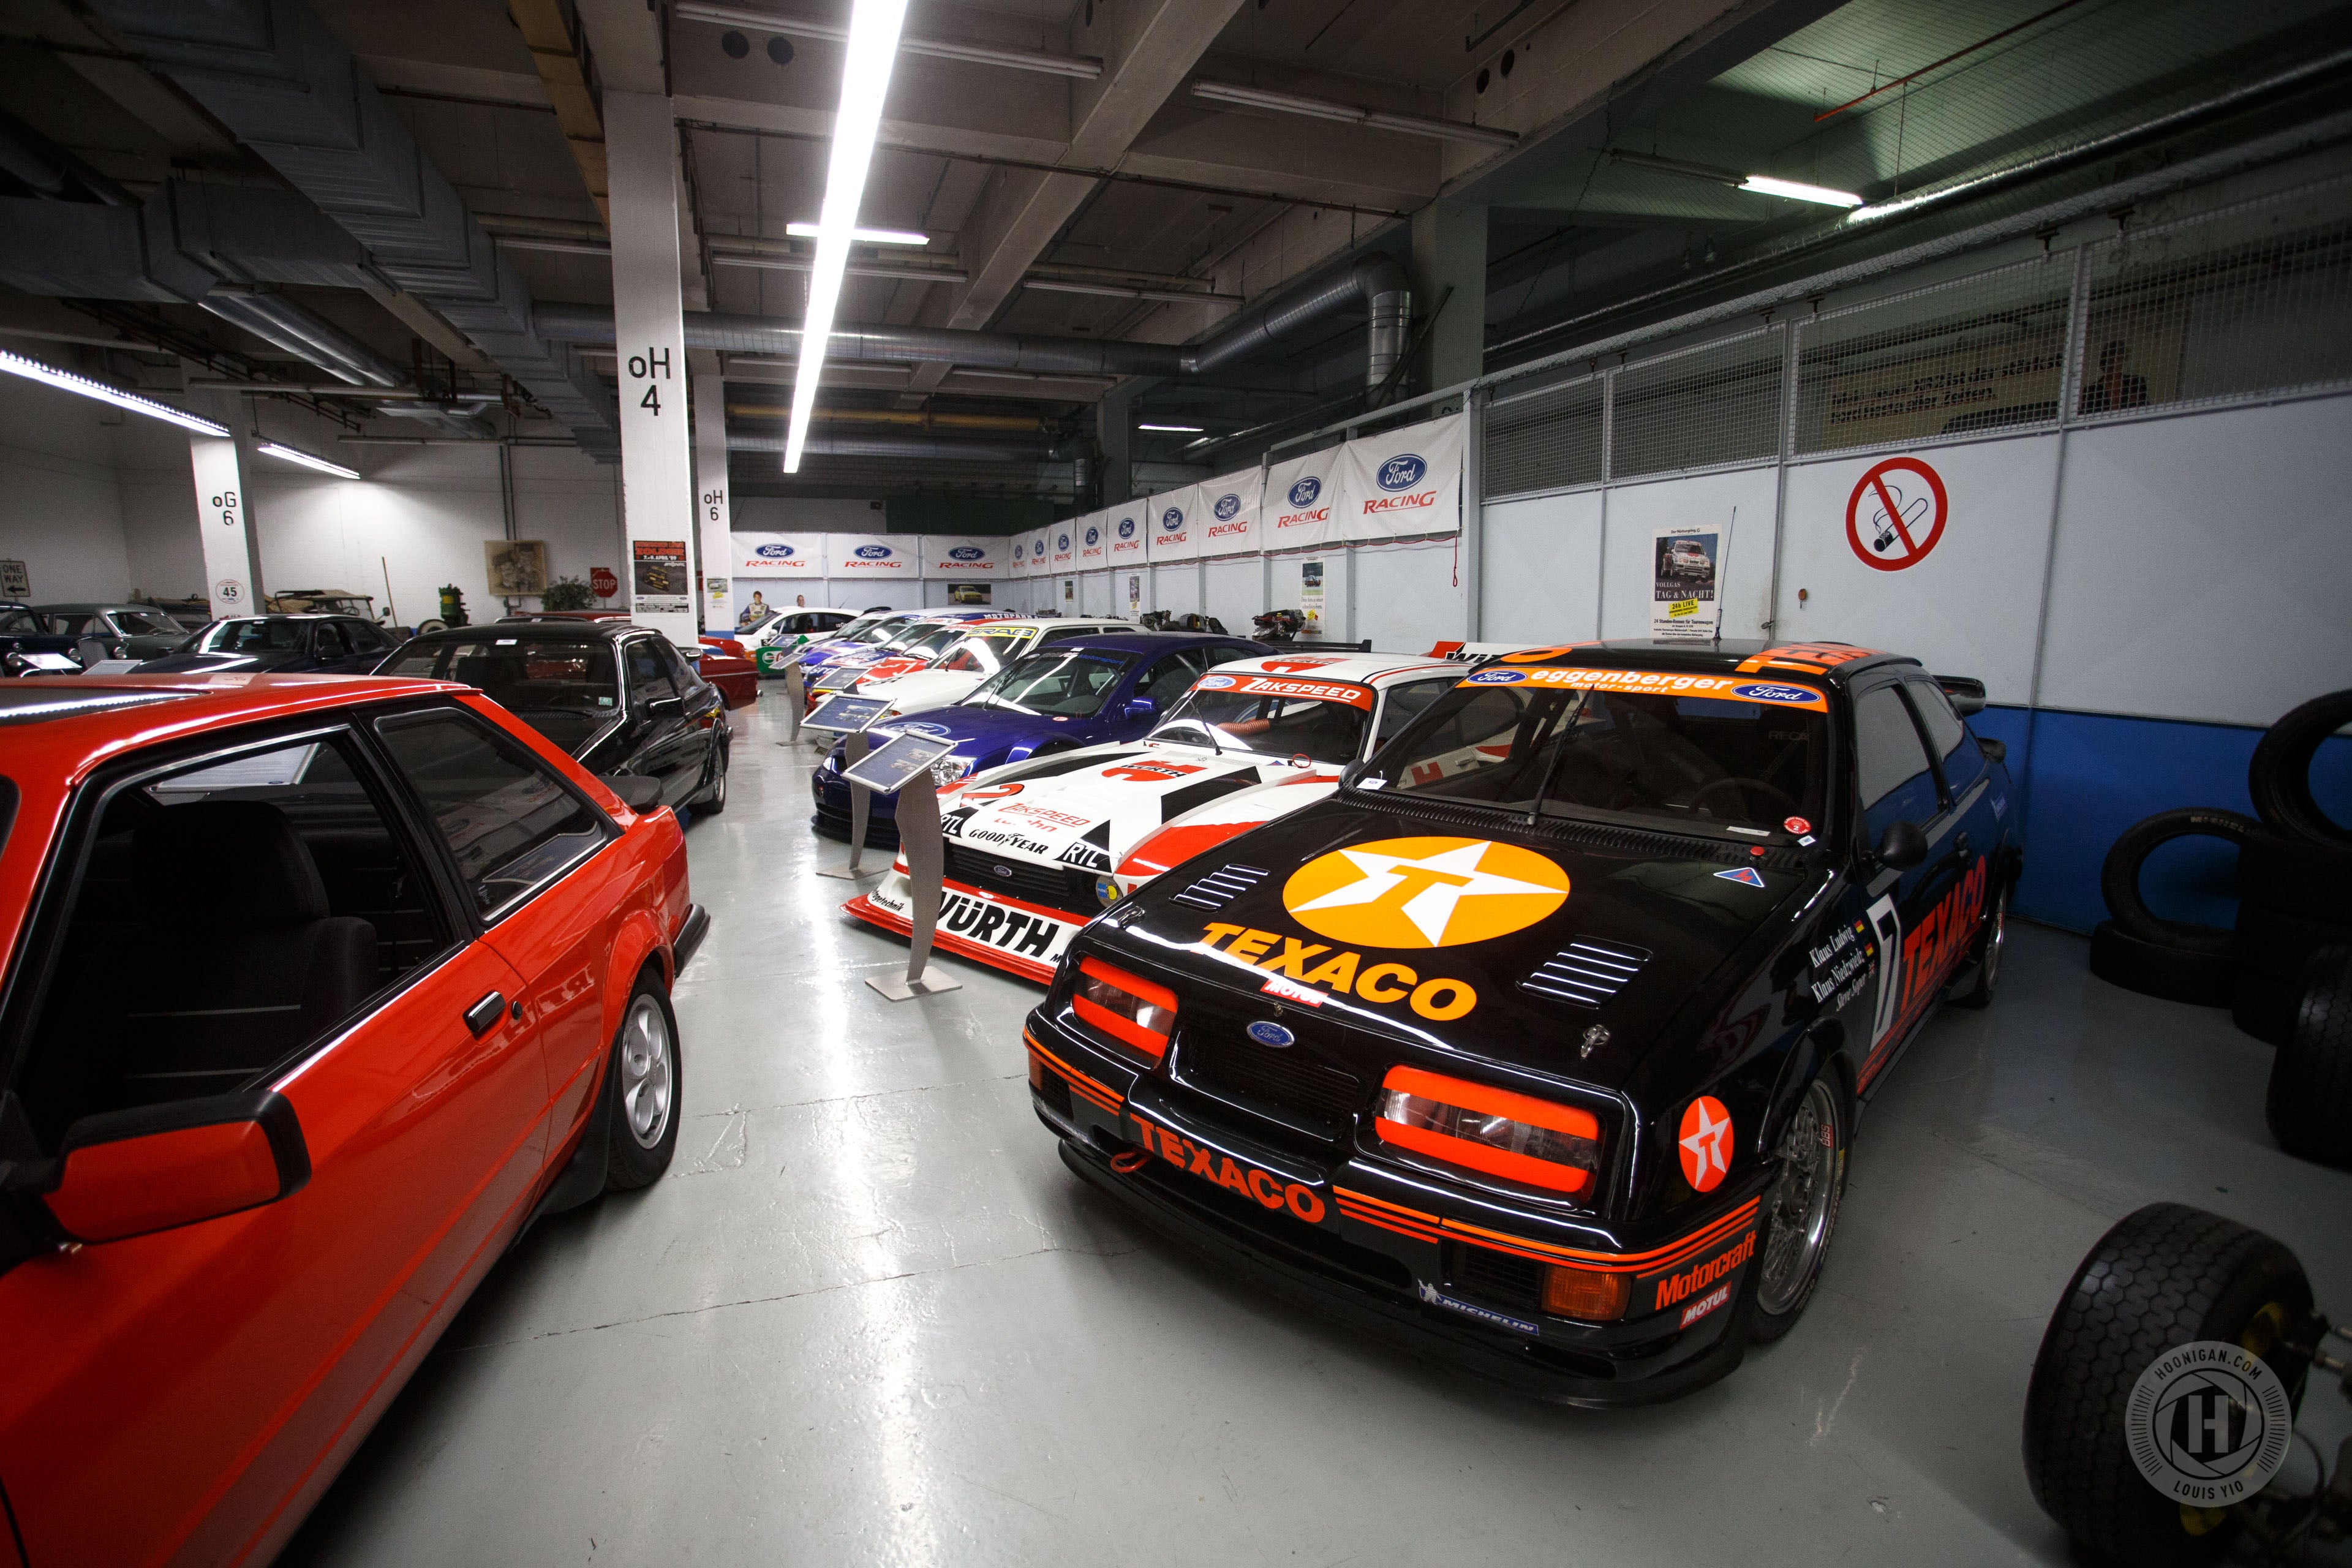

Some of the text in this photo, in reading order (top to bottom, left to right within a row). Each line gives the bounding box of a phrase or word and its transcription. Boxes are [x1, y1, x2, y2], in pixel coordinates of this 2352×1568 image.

[628, 347, 671, 379] oH
[641, 385, 661, 416] 4
[1385, 461, 1415, 483] Ford
[213, 492, 236, 507] oG
[704, 490, 723, 504] oH
[1292, 481, 1317, 503] Ford
[1217, 497, 1239, 517] Ford
[1363, 491, 1436, 514] RACING
[224, 511, 233, 526] 6
[710, 507, 719, 521] 6
[1166, 511, 1180, 527] Ford
[1278, 507, 1330, 528] RACING
[1120, 520, 1134, 537] Ford
[1208, 521, 1248, 538] RACING
[1114, 540, 1139, 552] RACING
[1157, 532, 1186, 545] RACING
[763, 545, 788, 557] Ford
[861, 546, 886, 558] Ford
[955, 548, 979, 559] Ford
[1055, 552, 1071, 562] RACING
[1083, 547, 1101, 557] RACING
[2, 565, 22, 573] ONE
[223, 587, 237, 597] 45
[593, 579, 616, 589] STOP
[1681, 590, 1714, 599] NACHT!
[1200, 676, 1232, 687] Ford
[1472, 671, 1522, 685] Ford
[1531, 669, 1734, 692] eggenberger
[1240, 677, 1361, 702] ZAKSPEED
[1749, 685, 1803, 701] Ford
[998, 802, 1091, 827] ZAKSPEED
[1063, 842, 1101, 868] RTL
[1900, 855, 1986, 1012] TEXACO
[1809, 924, 1856, 968] Klaus Ludwig
[1196, 922, 1477, 1021] TEXACO
[1866, 893, 1901, 1052] 7
[1811, 980, 1834, 1003] Klaus
[1254, 1025, 1284, 1042] Ford
[1130, 1112, 1325, 1223] TEXACO
[1656, 1230, 1756, 1311] Motorcraft
[1682, 1286, 1728, 1325] MOTUL
[1442, 1297, 1534, 1332] MICHELIN
